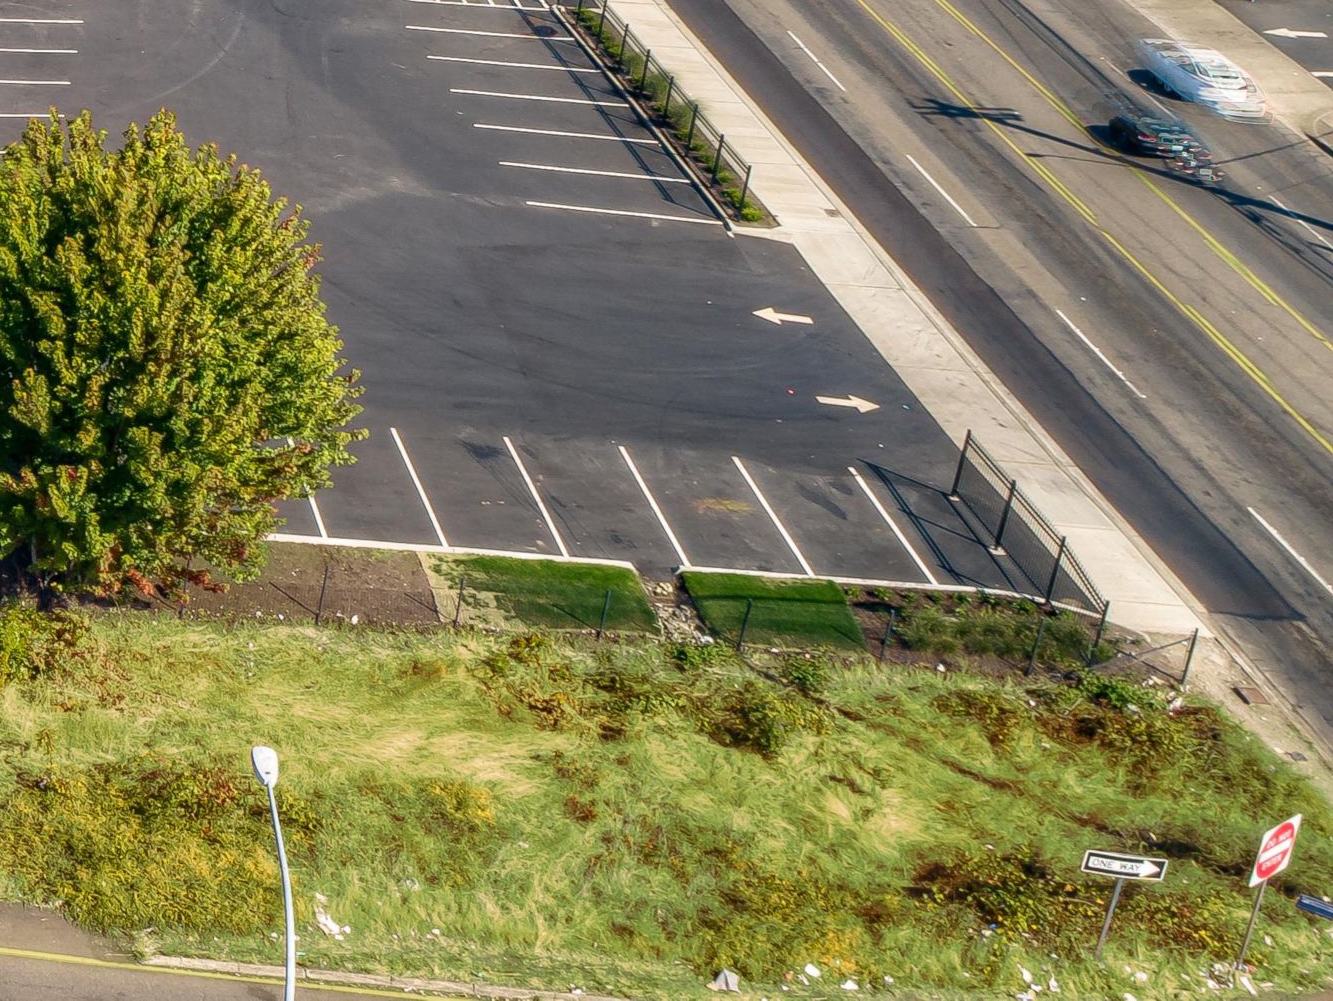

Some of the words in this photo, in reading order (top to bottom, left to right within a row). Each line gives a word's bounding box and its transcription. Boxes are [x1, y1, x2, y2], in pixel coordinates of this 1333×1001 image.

[1267, 837, 1277, 849] DO
[1092, 858, 1115, 869] ONE
[1119, 863, 1141, 872] WAY
